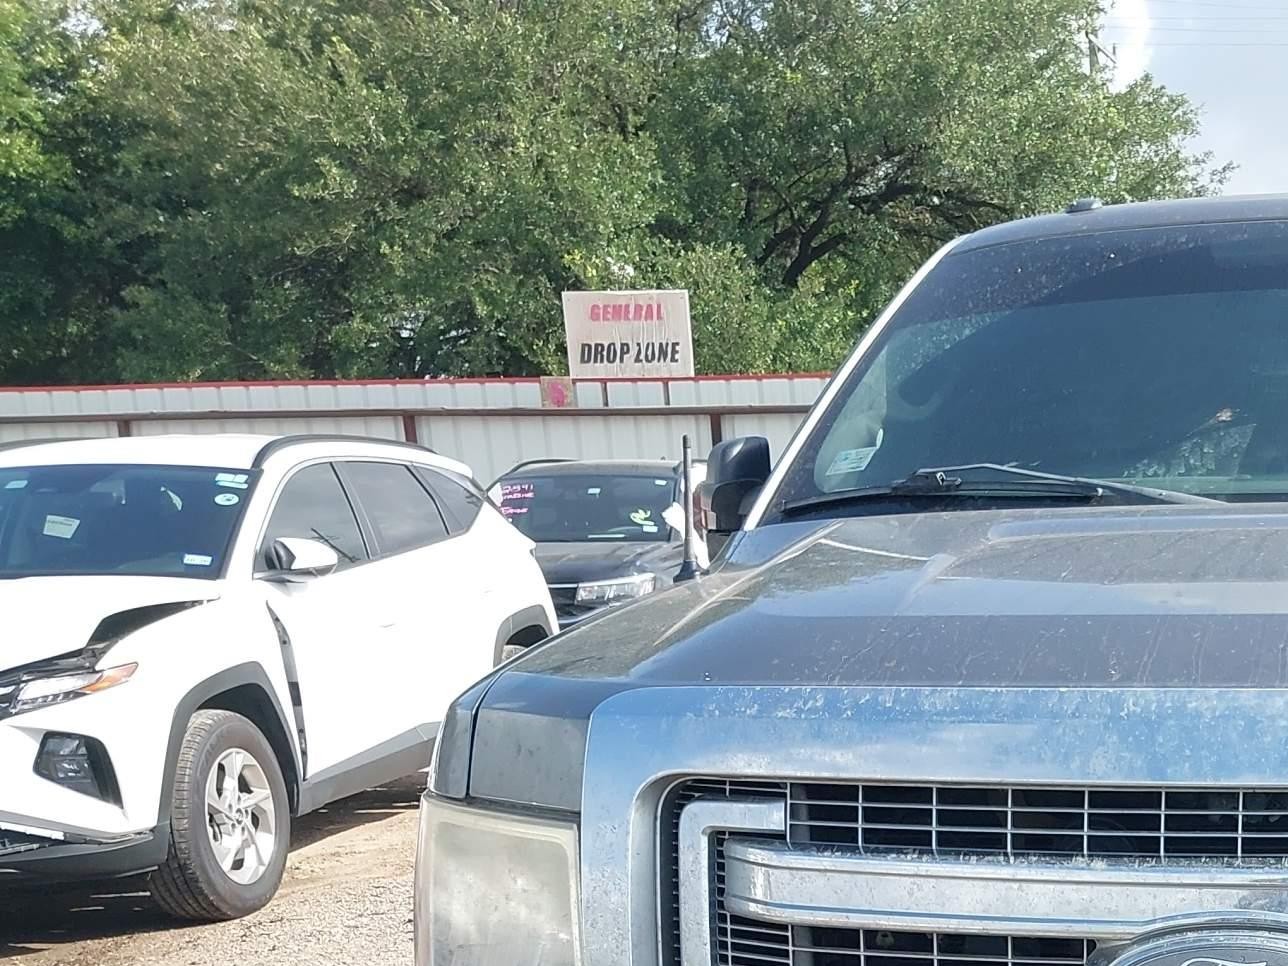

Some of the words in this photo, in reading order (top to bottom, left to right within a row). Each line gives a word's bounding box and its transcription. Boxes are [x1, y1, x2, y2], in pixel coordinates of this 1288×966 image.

[590, 303, 664, 322] GENERAL
[580, 342, 630, 364] DROP
[634, 341, 680, 364] ZONE
